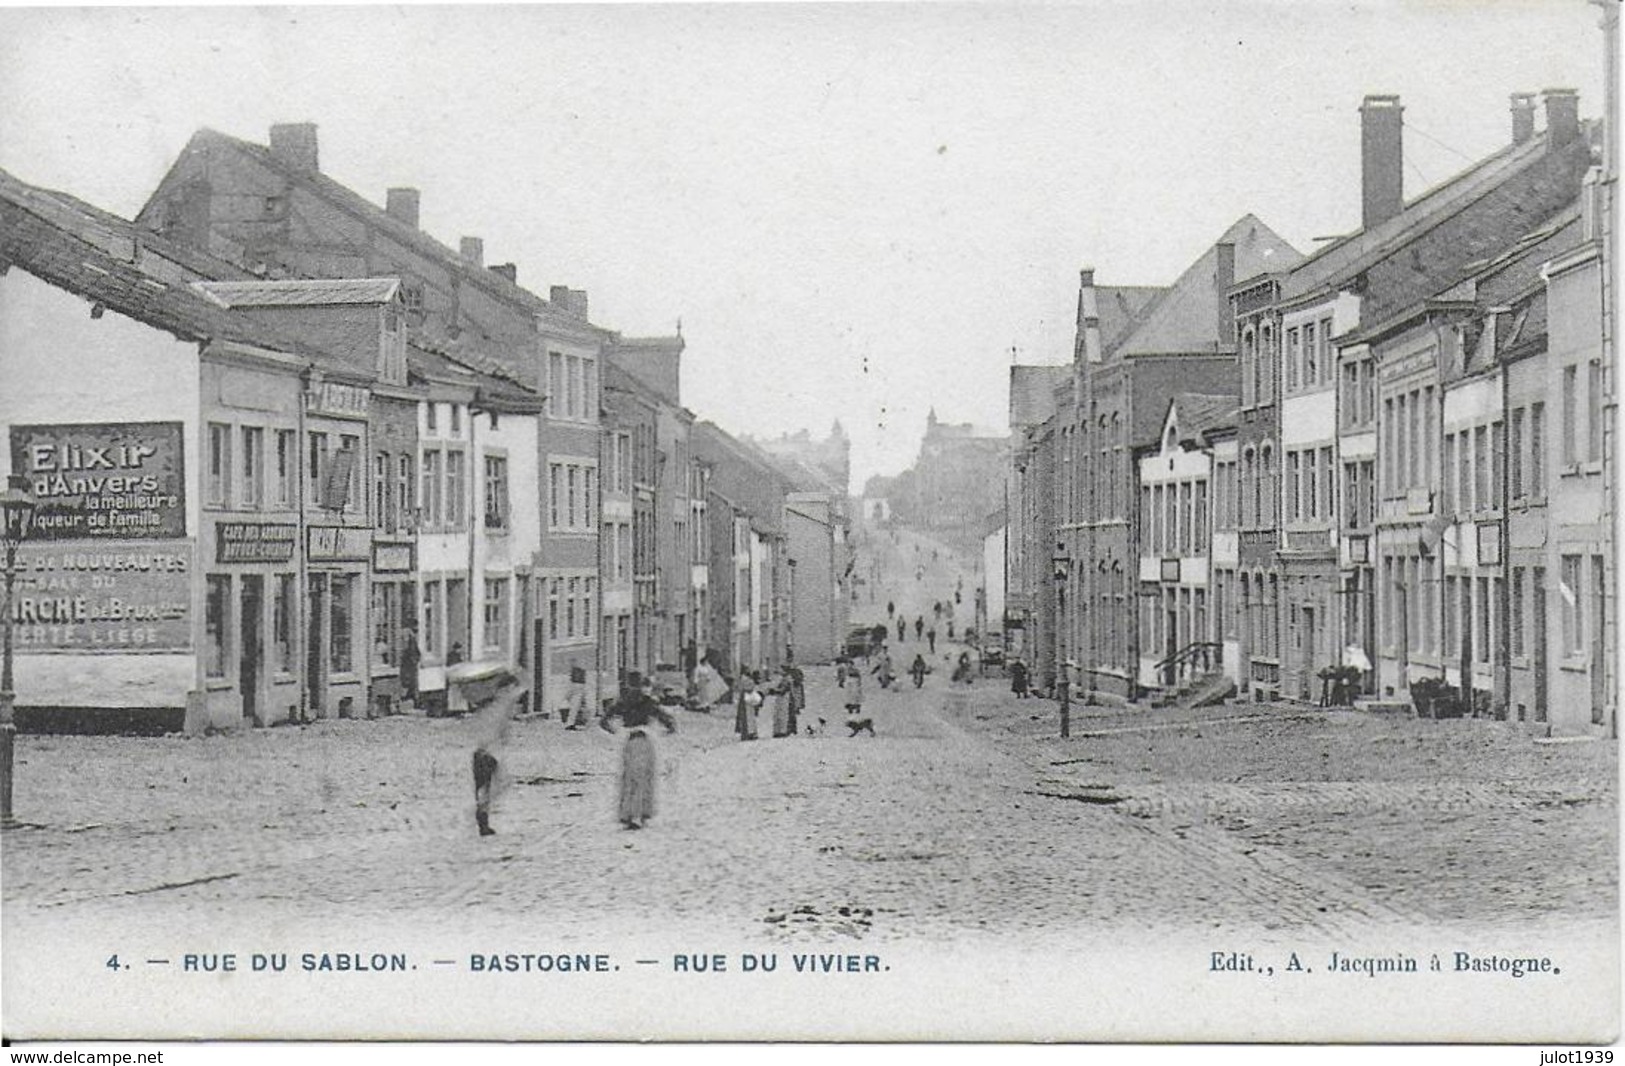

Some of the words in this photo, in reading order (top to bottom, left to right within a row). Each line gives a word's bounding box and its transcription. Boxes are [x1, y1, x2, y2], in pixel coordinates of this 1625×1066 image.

[32, 443, 157, 472] Elixir
[35, 474, 159, 497] d'Anvers
[101, 494, 178, 509] meilleure
[32, 511, 83, 530] iqueur
[109, 510, 160, 526] famille
